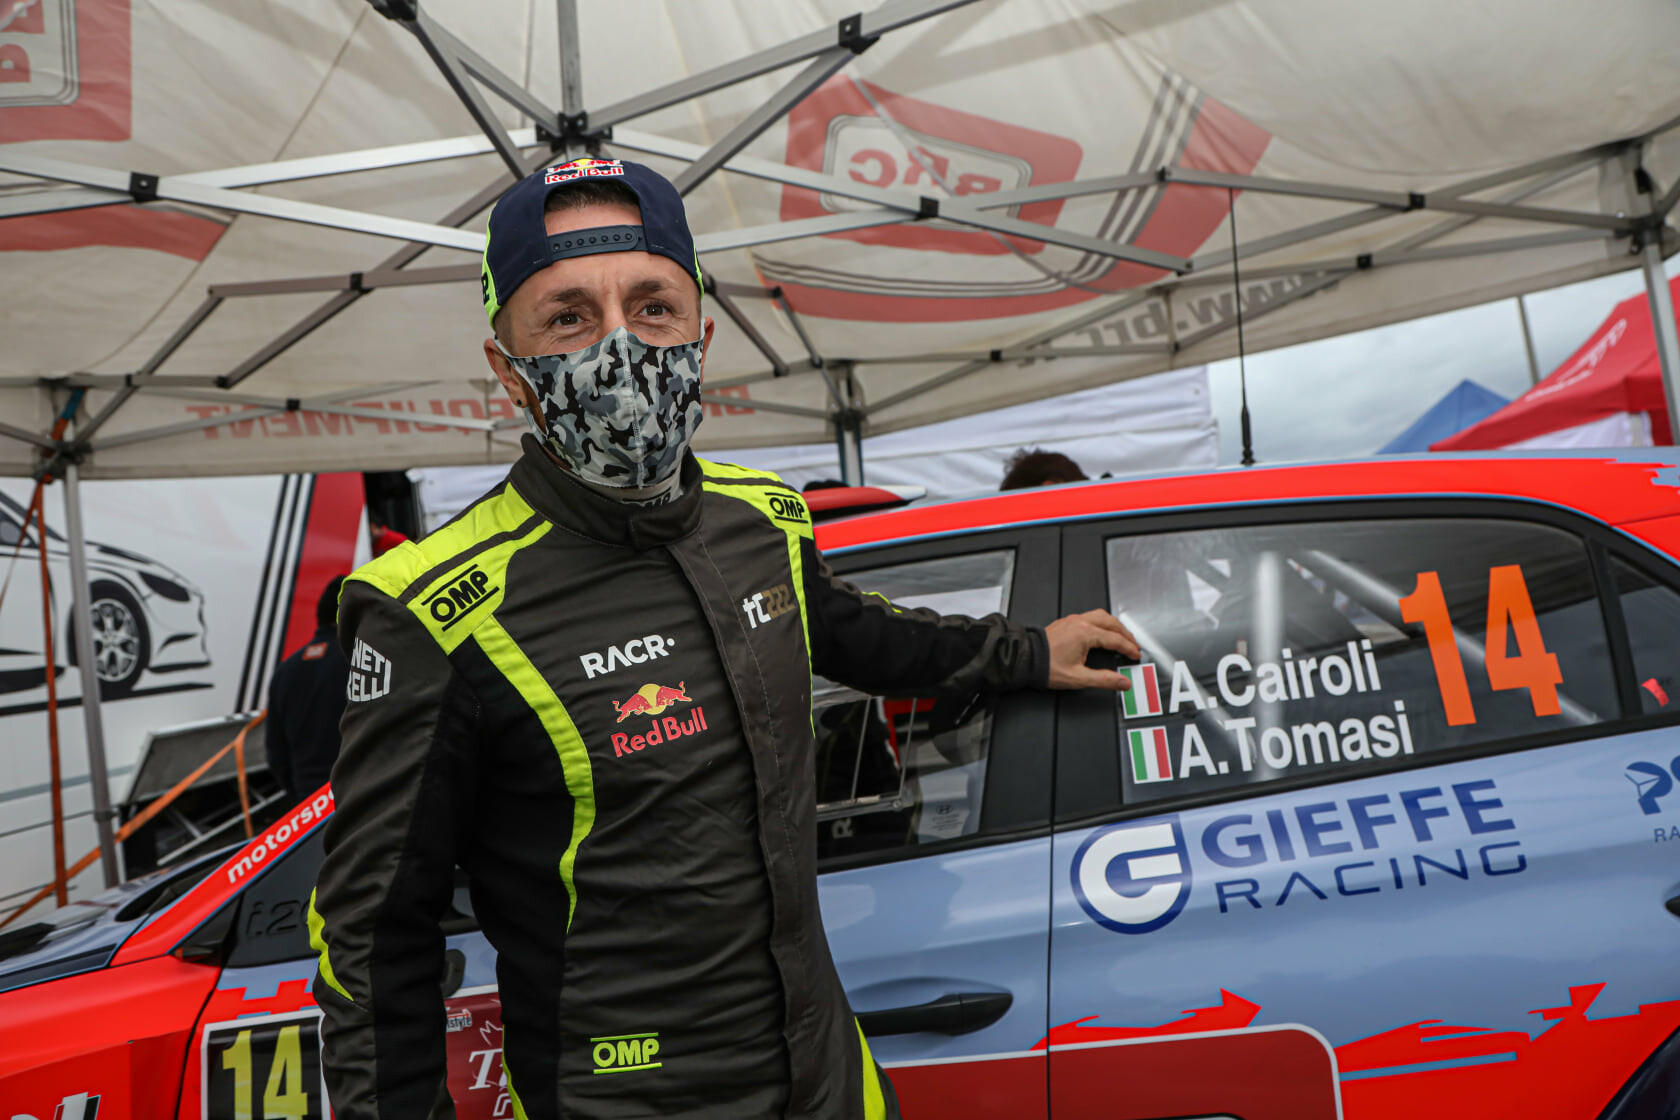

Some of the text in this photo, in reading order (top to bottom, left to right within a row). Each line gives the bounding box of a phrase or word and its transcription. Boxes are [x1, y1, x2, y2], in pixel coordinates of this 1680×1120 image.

[545, 167, 624, 184] Red Bull
[769, 497, 805, 519] OMP
[430, 570, 489, 623] OMP
[1168, 639, 1382, 714] A.Cairoli
[1398, 564, 1564, 727] 14
[611, 706, 708, 757] Red Bull
[1178, 700, 1414, 779] A.Tomasi
[1201, 779, 1516, 868] GIEFFE
[1214, 841, 1528, 913] RACING
[222, 1025, 308, 1120] 14
[592, 1038, 660, 1068] OMP
